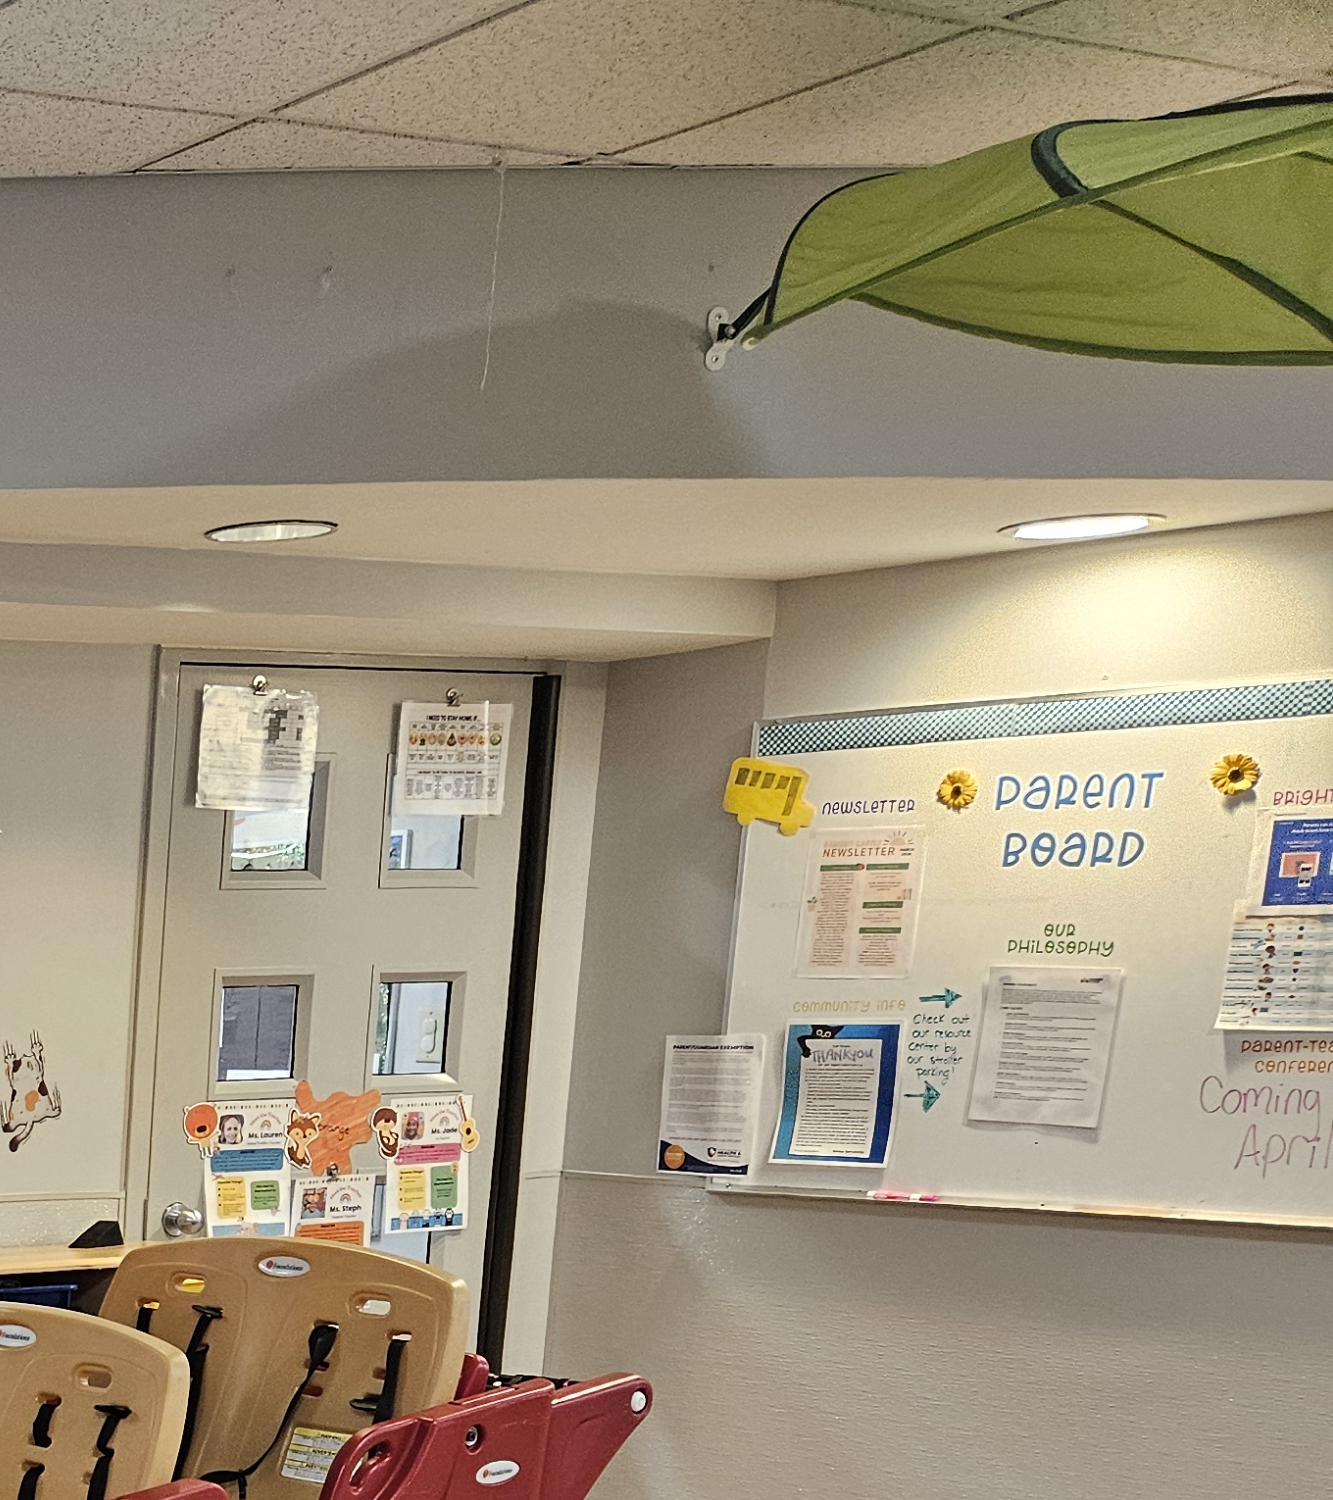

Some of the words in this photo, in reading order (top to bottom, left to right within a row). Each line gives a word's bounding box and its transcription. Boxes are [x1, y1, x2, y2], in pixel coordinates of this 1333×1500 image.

[822, 847, 895, 858] NEWSLETTER
[1044, 923, 1076, 937] OUR
[1007, 939, 1115, 957] PHILOSOPHY
[912, 1013, 945, 1025] Check
[951, 1015, 971, 1025] out
[911, 1029, 931, 1038] our
[934, 1028, 972, 1038] resource
[908, 1041, 939, 1052] center
[944, 1042, 957, 1055] by
[906, 1055, 924, 1064] our
[1199, 1075, 1321, 1142] Coming
[260, 1131, 283, 1139] Lauren
[1234, 1120, 1333, 1180] April
[342, 1205, 362, 1213] Steph
